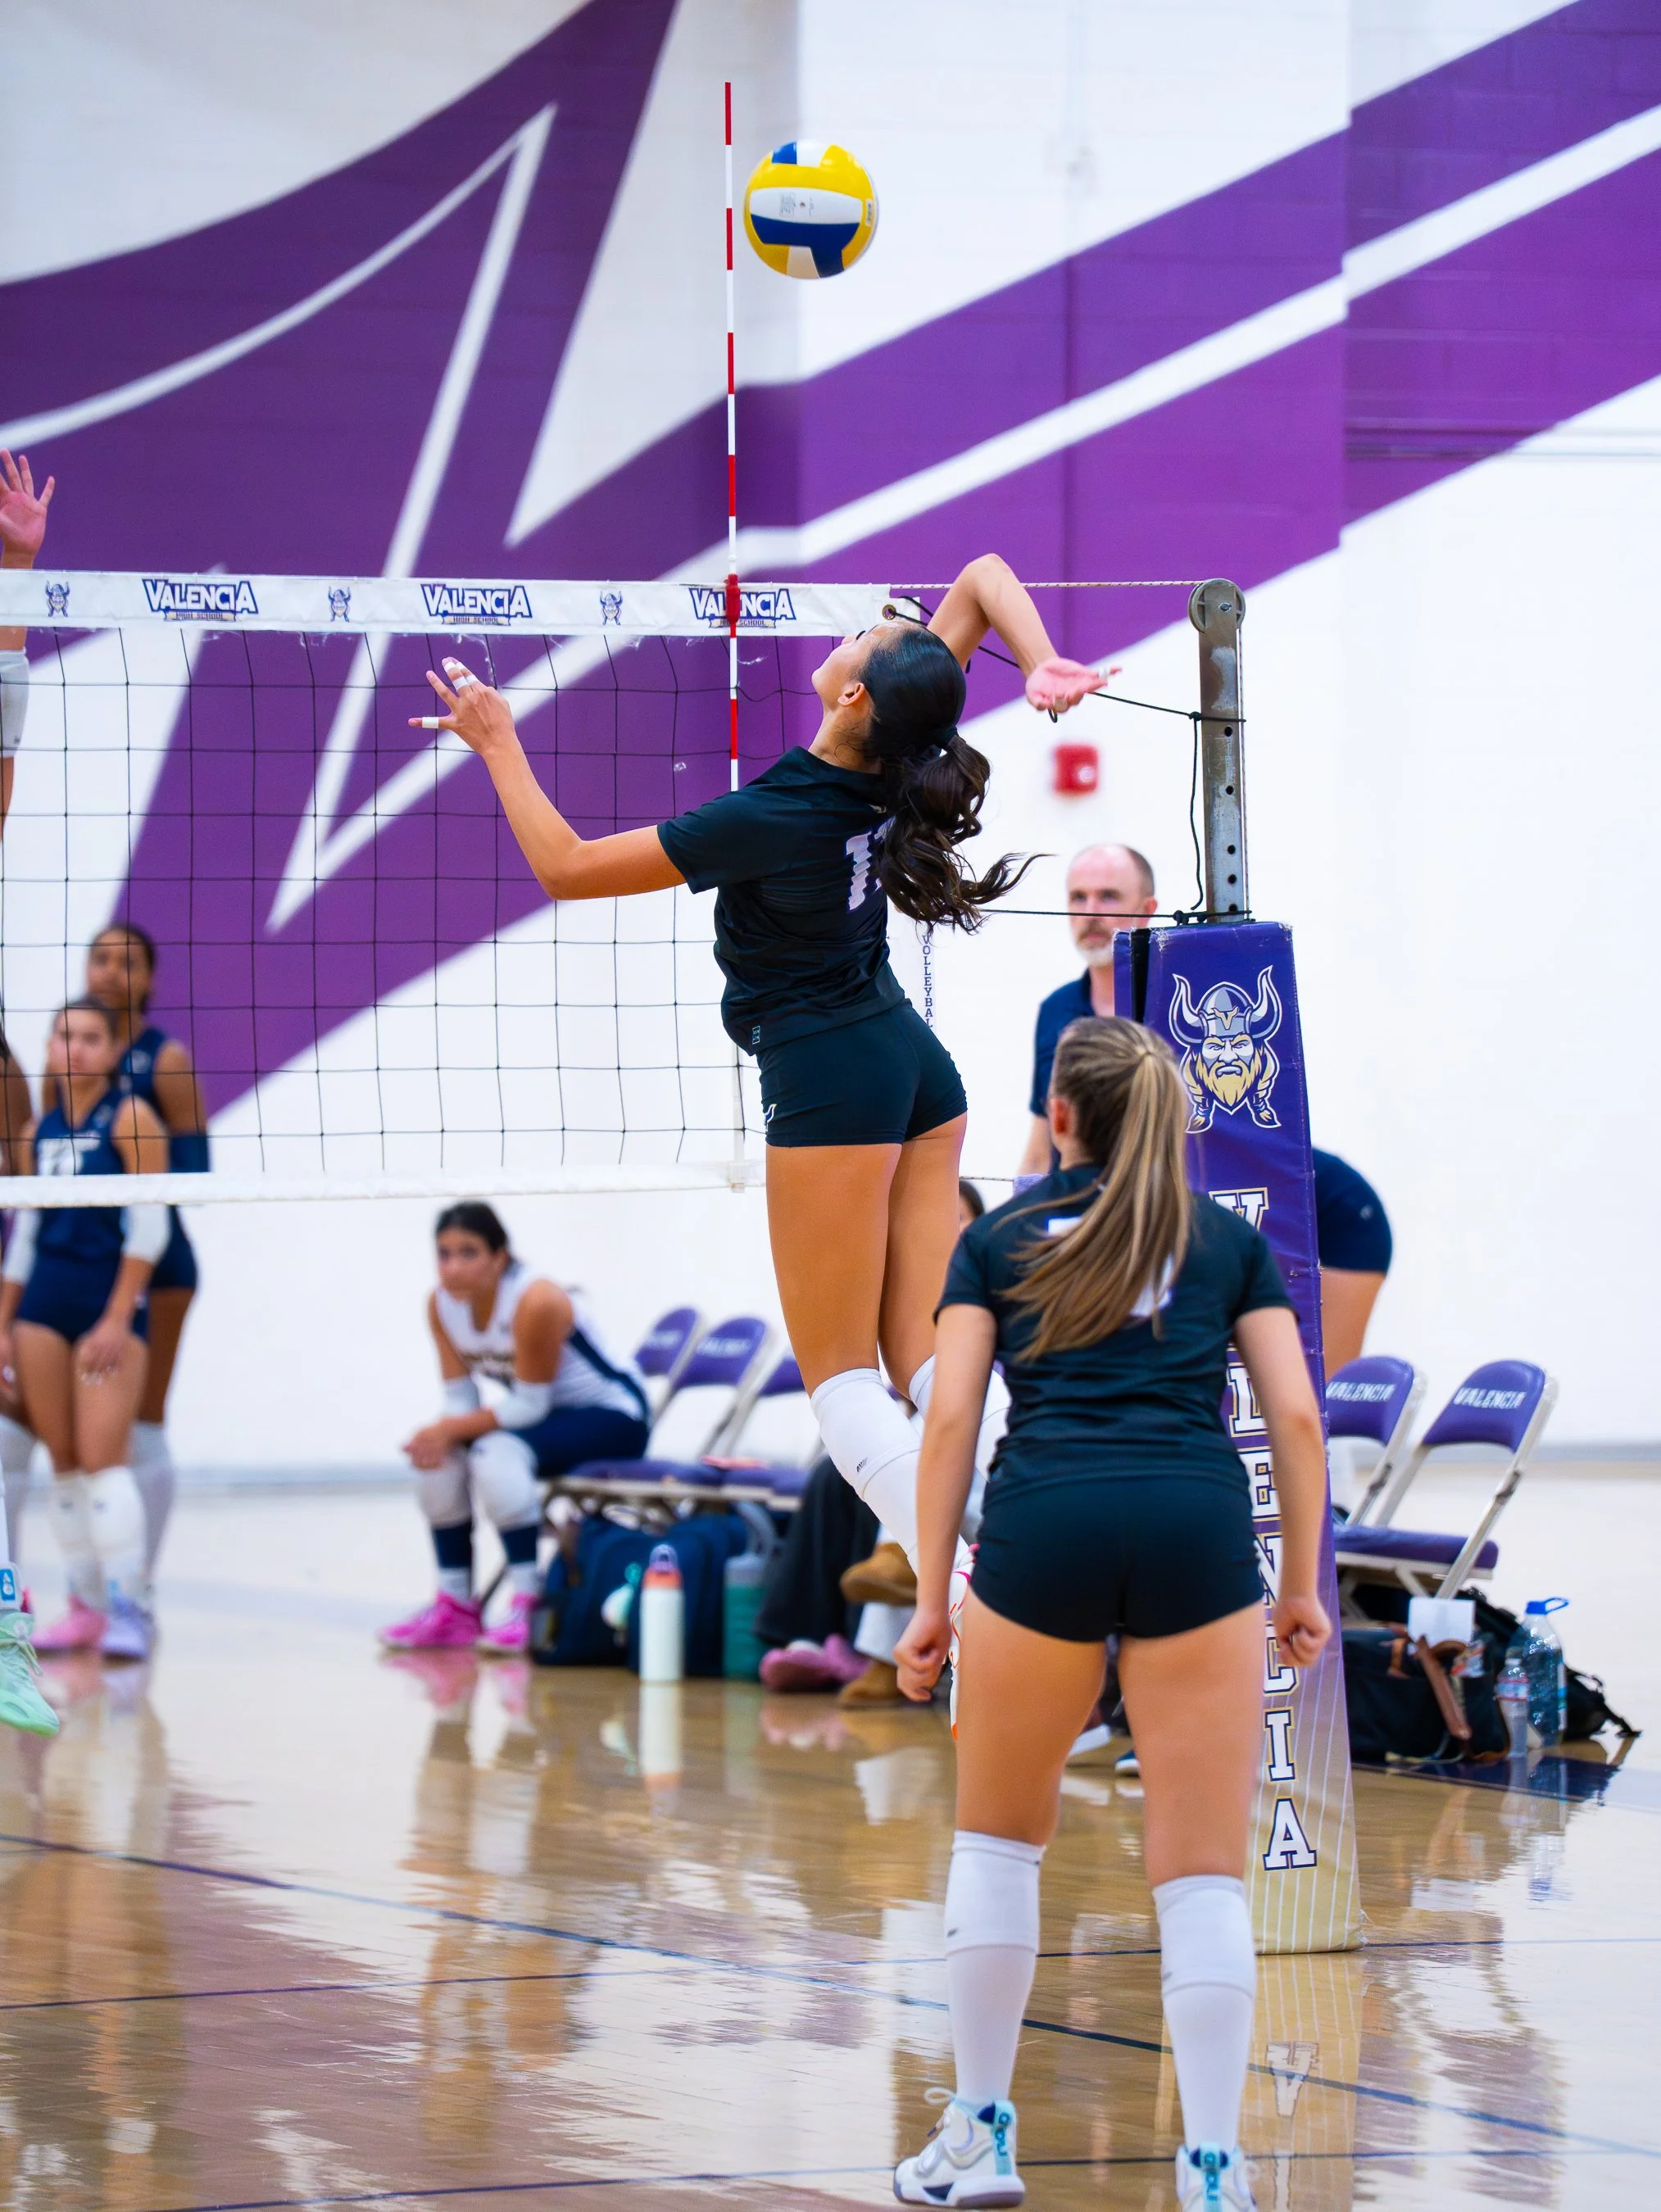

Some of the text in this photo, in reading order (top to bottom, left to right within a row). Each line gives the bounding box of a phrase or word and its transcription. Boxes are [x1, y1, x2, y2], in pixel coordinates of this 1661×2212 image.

[142, 578, 259, 614] VALENCIA
[420, 583, 533, 618] VALENCIA
[688, 588, 796, 620] VALNCIA
[922, 935, 933, 1028] VOLLEYBAL
[1326, 1381, 1396, 1402] VALENCIA
[1453, 1388, 1527, 1409] VALENCIA
[1209, 1187, 1318, 1871] VLENCIA
